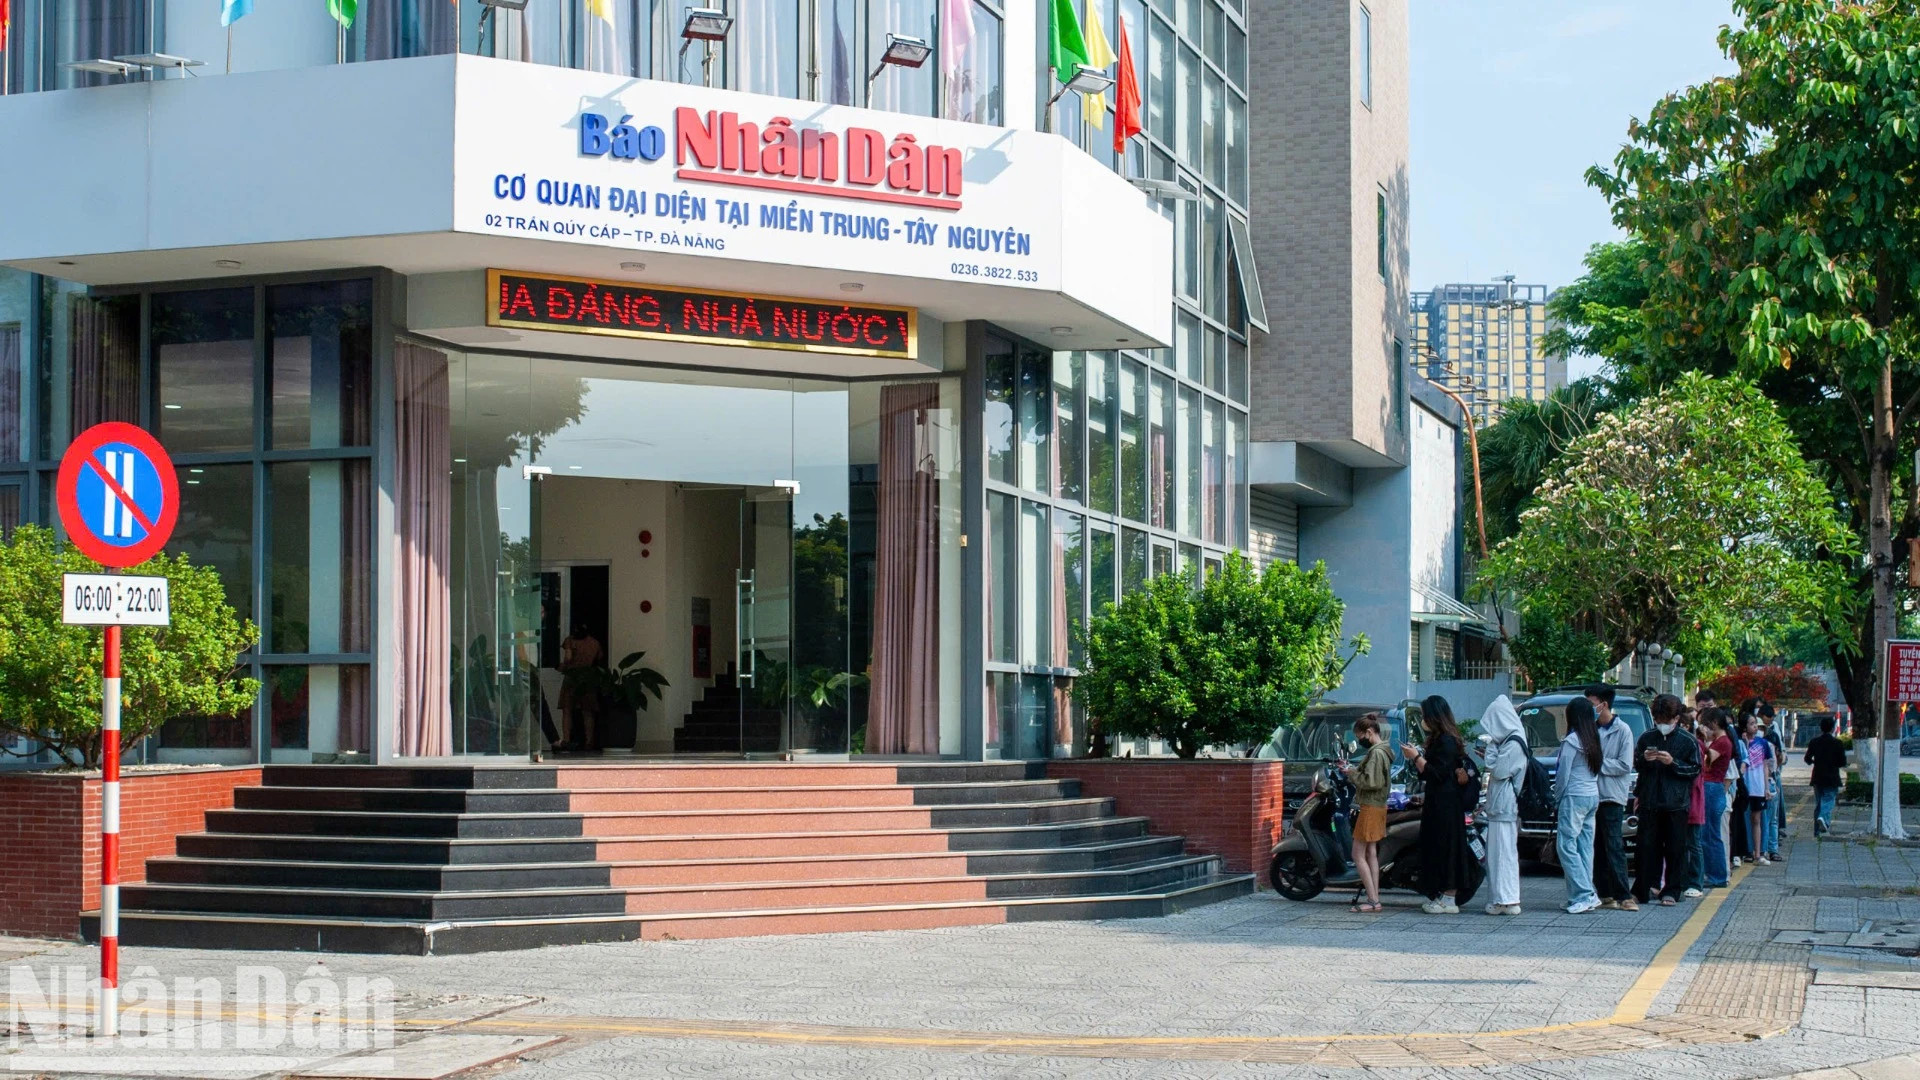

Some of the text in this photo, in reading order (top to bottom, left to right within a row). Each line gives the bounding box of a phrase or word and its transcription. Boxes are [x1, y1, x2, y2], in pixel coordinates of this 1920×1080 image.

[581, 106, 962, 196] Báo Nhân Dân
[485, 213, 503, 227] 02
[660, 230, 680, 246] ĐÀ
[494, 173, 526, 200] CƠ
[536, 179, 600, 210] QUAN
[608, 187, 646, 218] ĐẠI
[655, 190, 706, 225] DIỆN
[715, 198, 749, 230] TẠI
[760, 199, 814, 233] MIỀN
[820, 211, 889, 242] TRUNG
[903, 216, 938, 246] TÂY
[948, 226, 1031, 256] NGUYÊN
[951, 262, 1039, 283] 0236.3822.533
[546, 282, 672, 334] ĐẢNG,
[682, 298, 763, 337] NHÀ
[773, 304, 888, 346] NƯỚC
[75, 585, 112, 612] 06:00
[127, 586, 162, 612] 22:00
